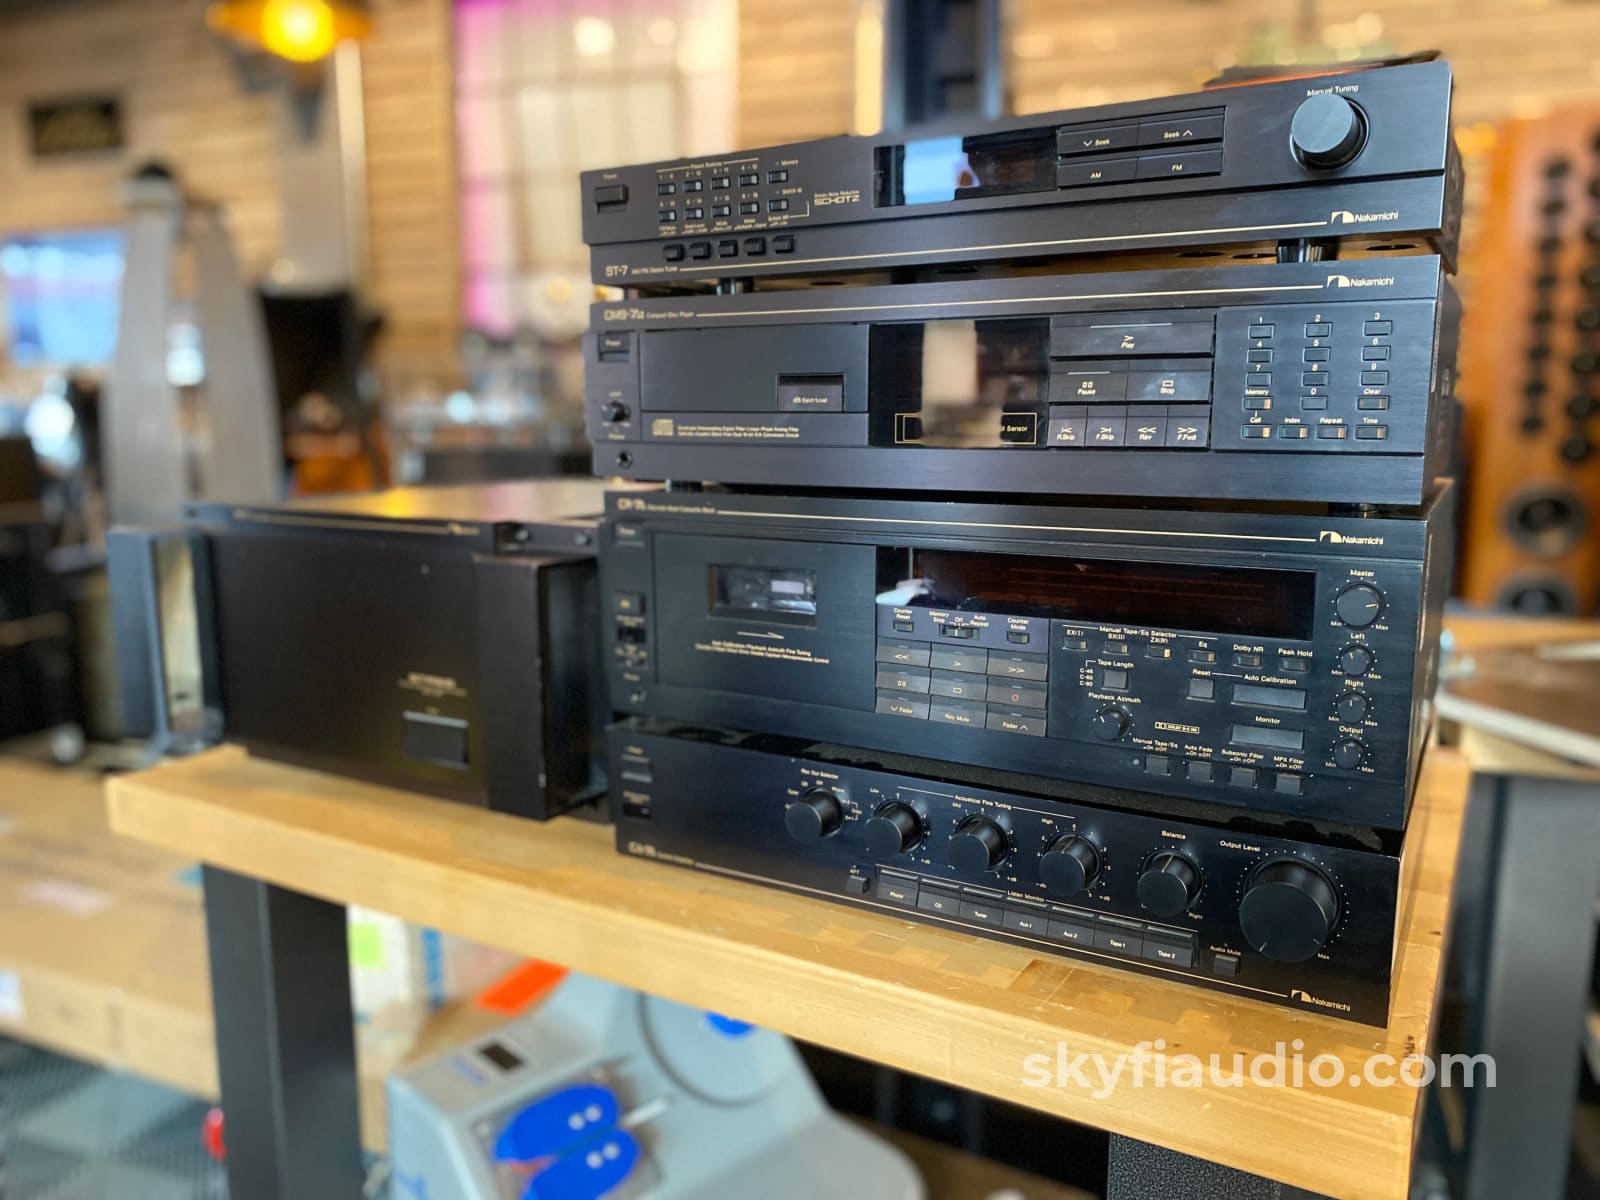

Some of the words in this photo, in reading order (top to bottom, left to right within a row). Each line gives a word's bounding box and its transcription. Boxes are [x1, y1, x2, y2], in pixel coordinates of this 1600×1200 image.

[1307, 88, 1333, 97] Manual
[1335, 84, 1359, 93] Tuning
[1163, 131, 1180, 139] Seek
[1095, 138, 1110, 146] Seek
[1171, 164, 1183, 172] FM
[1354, 210, 1399, 222] Nakamichi
[1350, 276, 1394, 287] Nakamichi
[1314, 314, 1320, 322] 2
[1121, 342, 1135, 350] Play
[1078, 388, 1096, 396] Pause
[1160, 387, 1175, 395] Stop
[1245, 388, 1270, 396] Memory
[1319, 416, 1343, 424] Repeat
[1342, 535, 1384, 546] Nakamichi
[1350, 569, 1375, 577] Master
[928, 610, 950, 618] Memory
[1008, 617, 1030, 625] Counter
[1098, 626, 1122, 634] Manual
[1150, 630, 1178, 638] Selector
[1350, 632, 1365, 640] Left
[1198, 640, 1208, 649] Eq
[1233, 644, 1252, 653] Dolby
[1278, 648, 1295, 656] Peak
[1296, 648, 1313, 658] Hold
[1097, 658, 1112, 667] Tape
[1112, 660, 1134, 669] Length
[1192, 668, 1211, 676] Reset
[1244, 674, 1260, 682] Auto
[1261, 675, 1297, 685] Calibration
[1345, 679, 1364, 688] Right
[1088, 692, 1114, 701] Playback
[1116, 695, 1142, 704] Azimuth
[1256, 716, 1281, 725] Monitor
[1339, 726, 1364, 734] Output
[1132, 738, 1153, 746] Manual
[1249, 752, 1264, 760] Filter
[1289, 757, 1304, 765] Filter
[1161, 830, 1186, 840] Balance
[1220, 840, 1242, 850] Output
[1243, 844, 1261, 853] Level
[1024, 894, 1046, 902] Monitor
[1110, 939, 1122, 948] Tape
[1157, 950, 1171, 959] Tape
[1210, 945, 1226, 954] Audio
[1226, 948, 1242, 957] Mute
[1311, 996, 1352, 1013] Nakamichi
